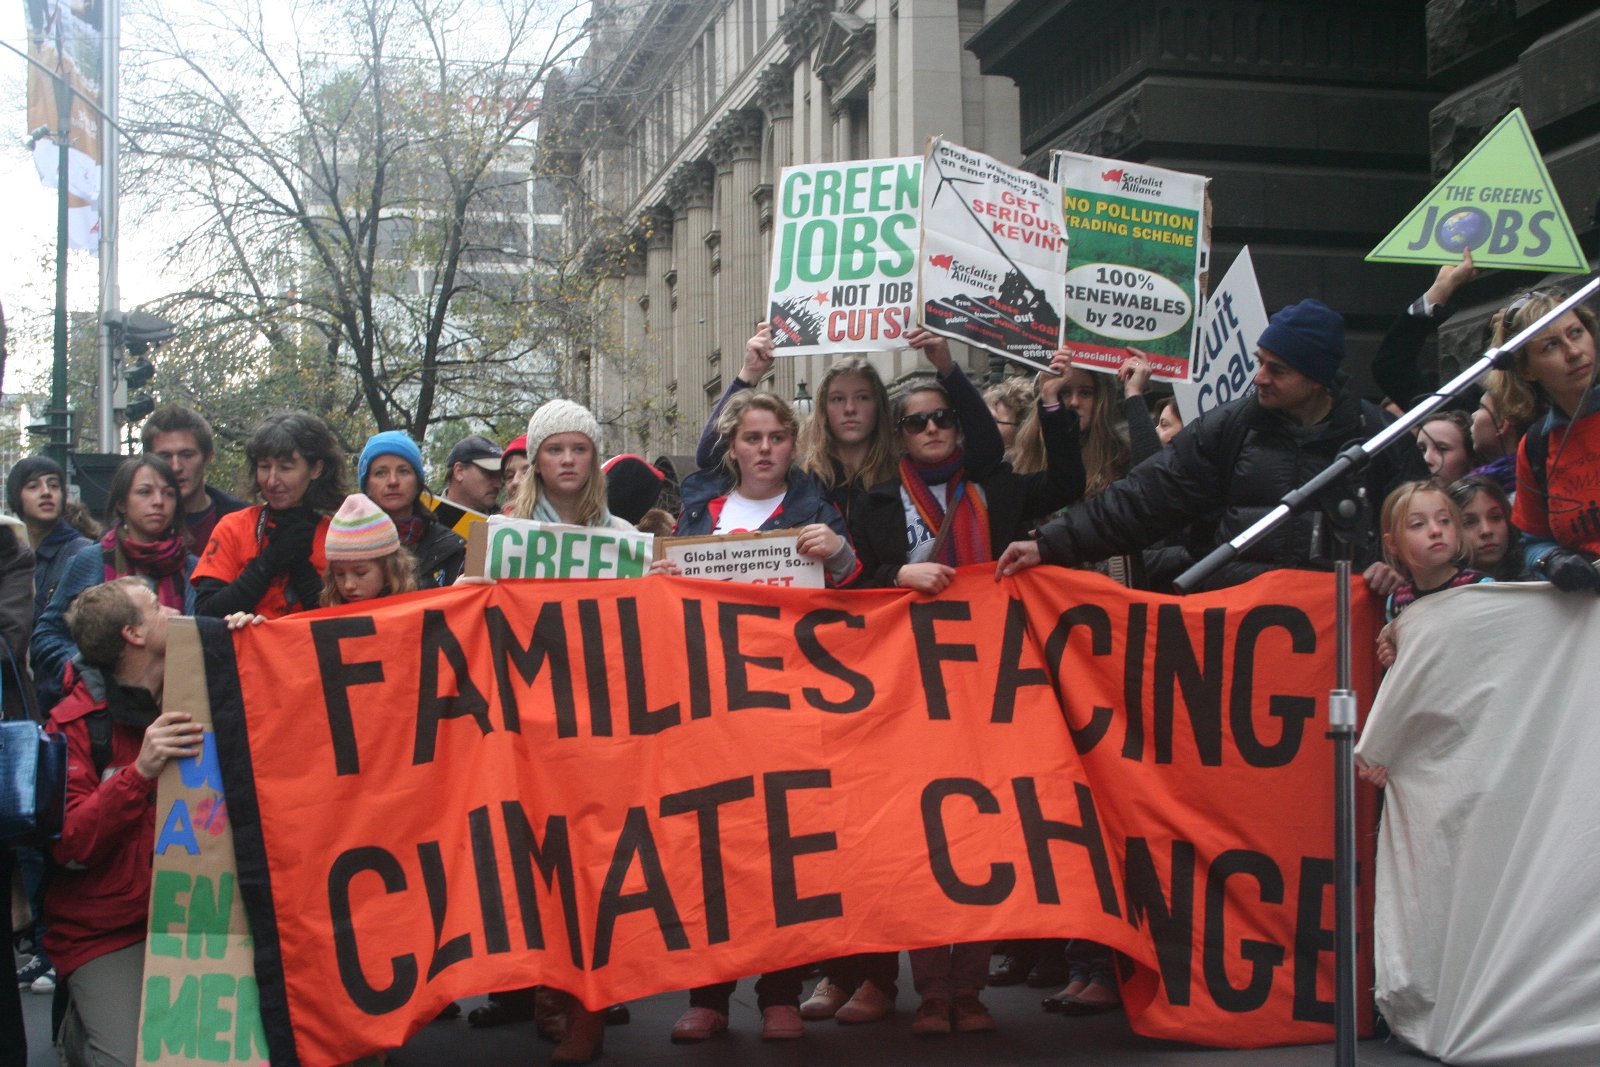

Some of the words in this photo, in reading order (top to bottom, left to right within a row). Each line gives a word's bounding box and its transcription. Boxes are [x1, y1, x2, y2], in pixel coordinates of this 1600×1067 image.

[940, 147, 981, 168] Global
[985, 161, 1038, 190] warming
[1040, 184, 1049, 194] is
[941, 158, 956, 169] an
[960, 164, 1028, 196] emergency
[1122, 172, 1164, 188] Socialist
[783, 163, 922, 219] GREEN
[1001, 191, 1040, 214] GET
[1121, 181, 1162, 197] Alliance
[1445, 186, 1475, 201] THE
[1479, 187, 1544, 204] GREENS
[972, 199, 1061, 236] SERIOUS
[1064, 196, 1090, 213] NO
[1096, 200, 1194, 231] POLLUTION
[992, 221, 1062, 254] KEVIN!
[1065, 214, 1128, 236] TRADING
[1132, 226, 1194, 247] SCHEME
[1407, 206, 1555, 257] JOBS
[775, 213, 916, 292] JOBS
[951, 260, 998, 283] Socialist
[951, 270, 996, 293] Alliance
[1096, 267, 1154, 291] 100%
[831, 284, 870, 307] NOT
[878, 282, 914, 306] JOB
[1065, 284, 1186, 316] RENEWABLES
[828, 306, 912, 342] CUTS!
[1014, 311, 1035, 323] out
[1086, 307, 1107, 327] by
[1112, 312, 1157, 332] 2020
[490, 527, 645, 579] GREEN
[683, 550, 727, 563] Global
[731, 545, 791, 560] warming
[684, 564, 700, 576] an
[705, 559, 781, 574] emergency
[785, 558, 814, 568] so...
[310, 596, 876, 776] FAMILIES
[909, 594, 1316, 768] FACING
[327, 768, 843, 1016] CLIMATE
[920, 776, 1362, 1024] CHNGE
